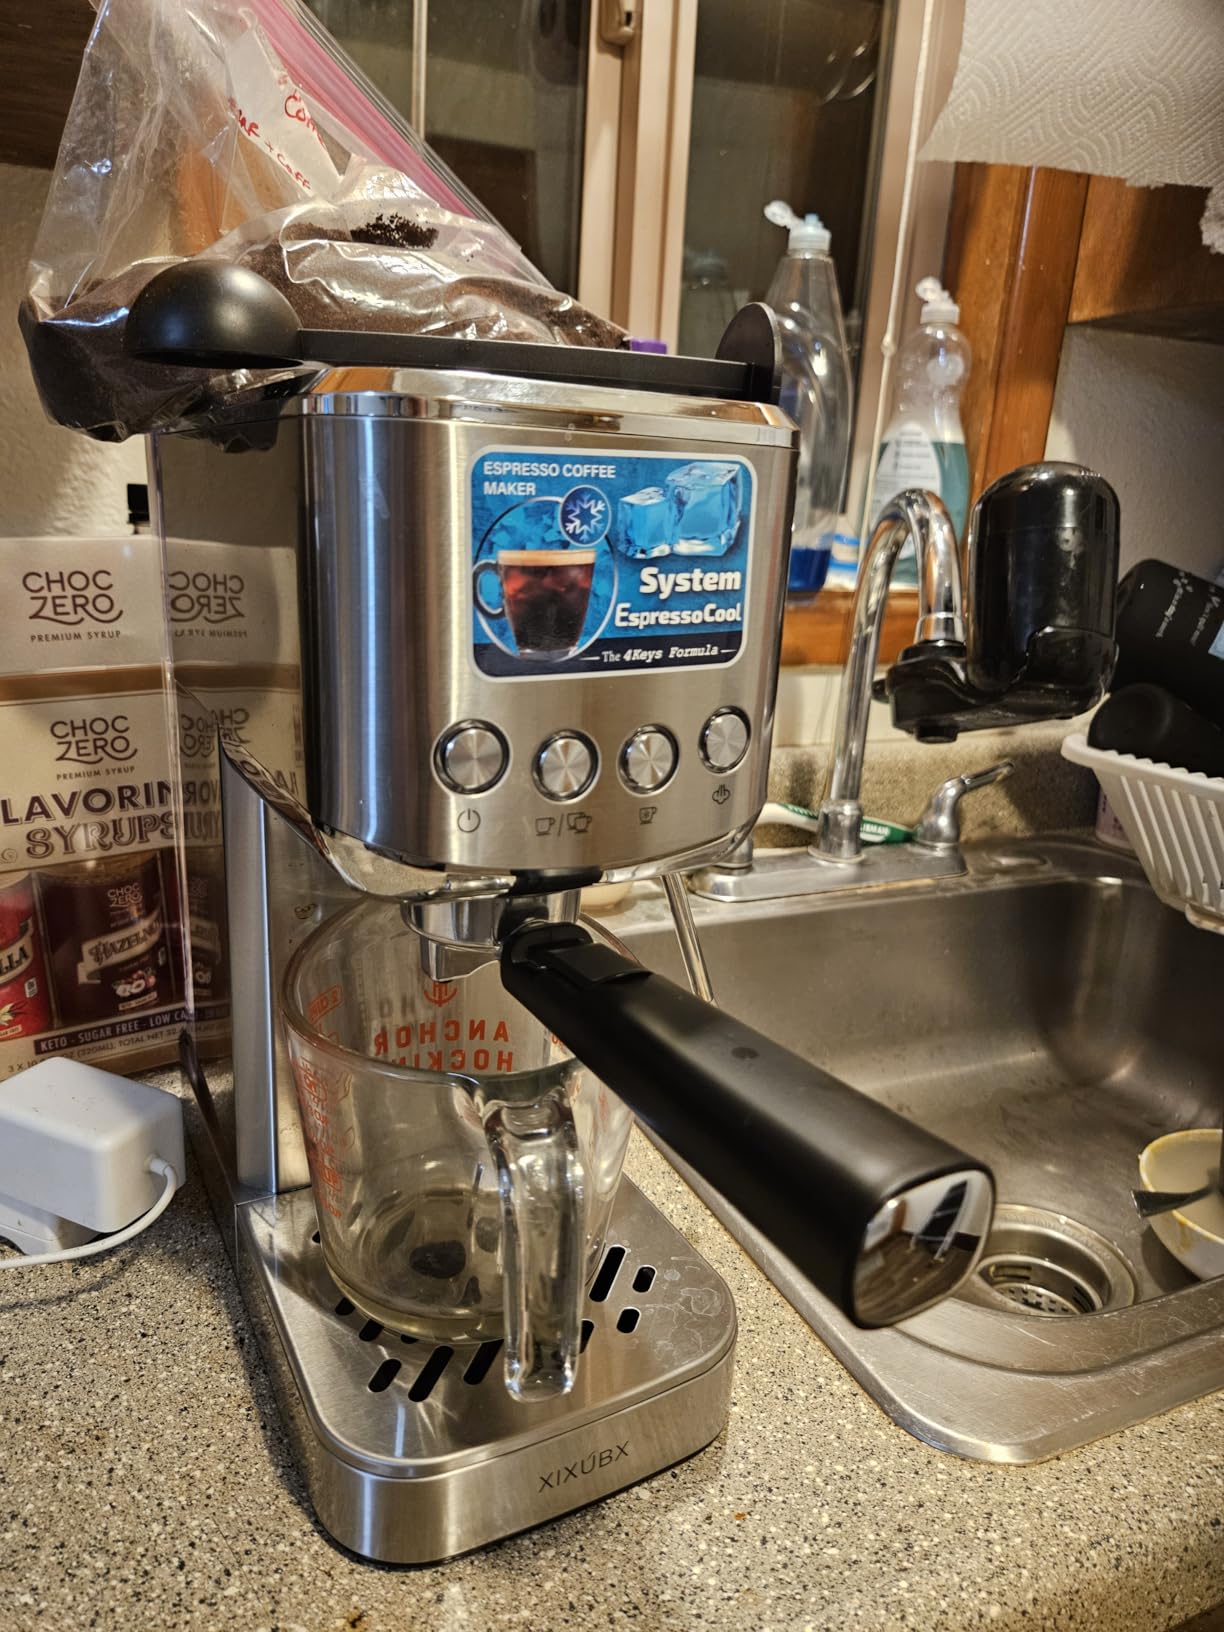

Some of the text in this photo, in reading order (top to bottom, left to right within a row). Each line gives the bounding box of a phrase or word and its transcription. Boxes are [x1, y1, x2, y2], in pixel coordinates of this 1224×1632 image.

[483, 461, 616, 478] ESPRESSO COFFEE
[483, 481, 536, 495] MAKER
[22, 570, 113, 592] CHOC
[639, 566, 741, 599] System
[29, 594, 123, 625] ZERO
[614, 603, 741, 630] EspressoCool
[30, 630, 121, 643] PREMIUM SYRUP
[602, 645, 718, 662] The 4Keys Formula
[51, 716, 129, 740] CHOC
[55, 735, 138, 765] ZERO
[56, 765, 136, 781] PREMIUM SYRUP
[0, 780, 173, 826] LAVORIN
[107, 883, 141, 898] CHOC
[40, 1037, 68, 1051] KETO
[78, 1028, 113, 1043] SUGAR
[116, 1020, 139, 1035] FREE
[150, 1013, 172, 1027] LOW
